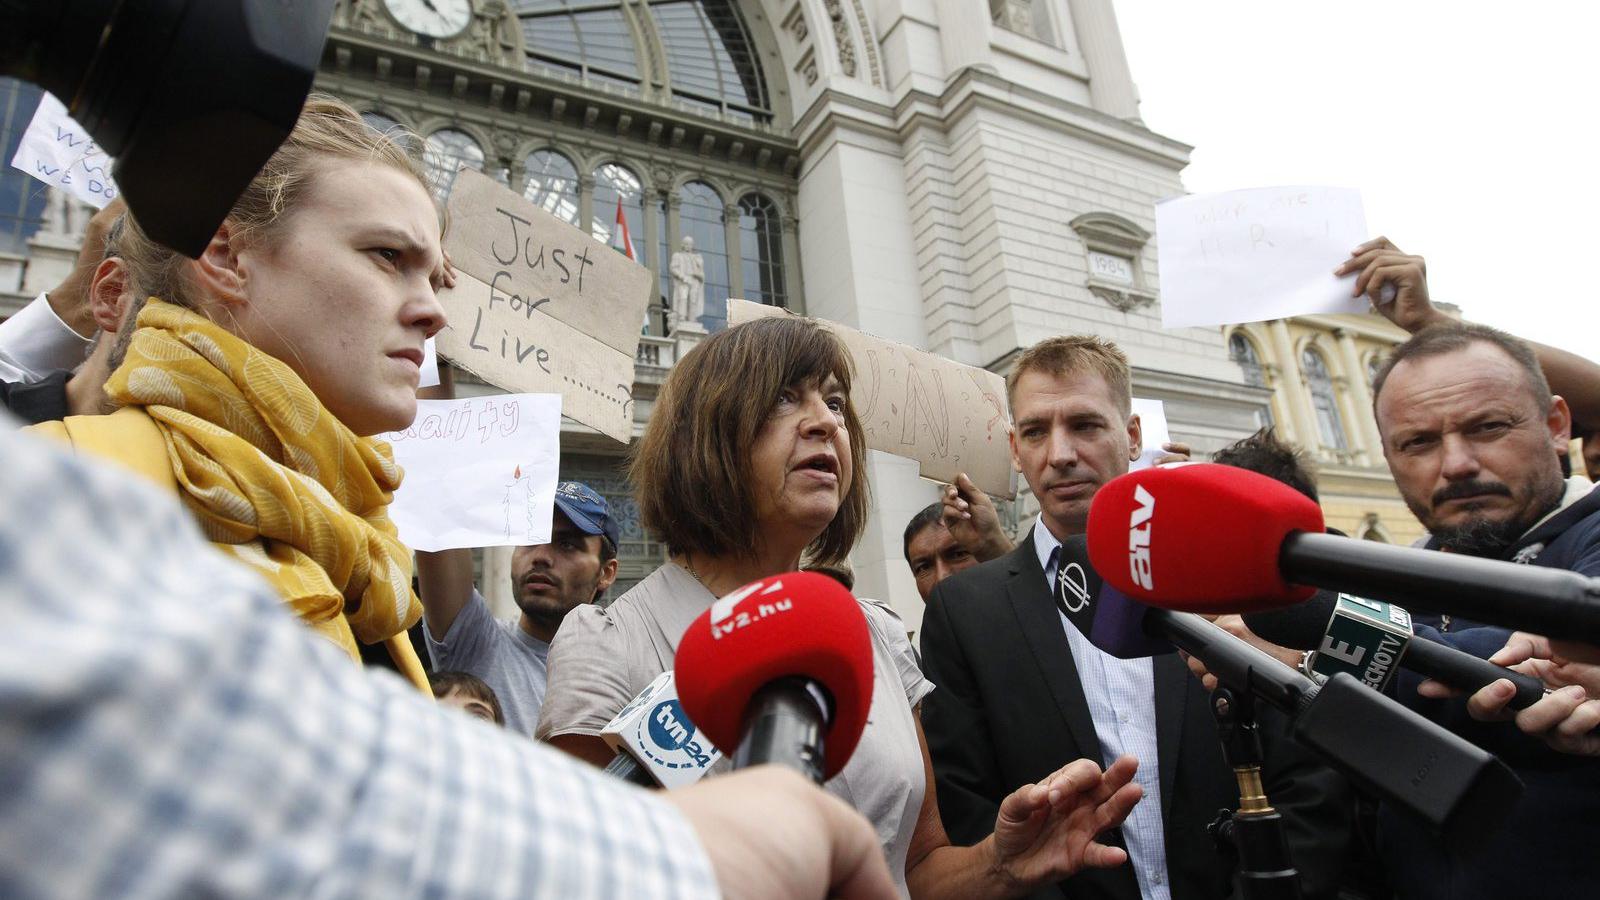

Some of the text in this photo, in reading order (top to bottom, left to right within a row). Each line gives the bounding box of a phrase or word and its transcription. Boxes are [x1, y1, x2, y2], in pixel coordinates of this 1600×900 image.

[36, 159, 72, 184] WE
[491, 207, 594, 293] Just
[1094, 255, 1126, 275] 1984
[469, 306, 551, 374] Live
[1129, 483, 1156, 591] atv
